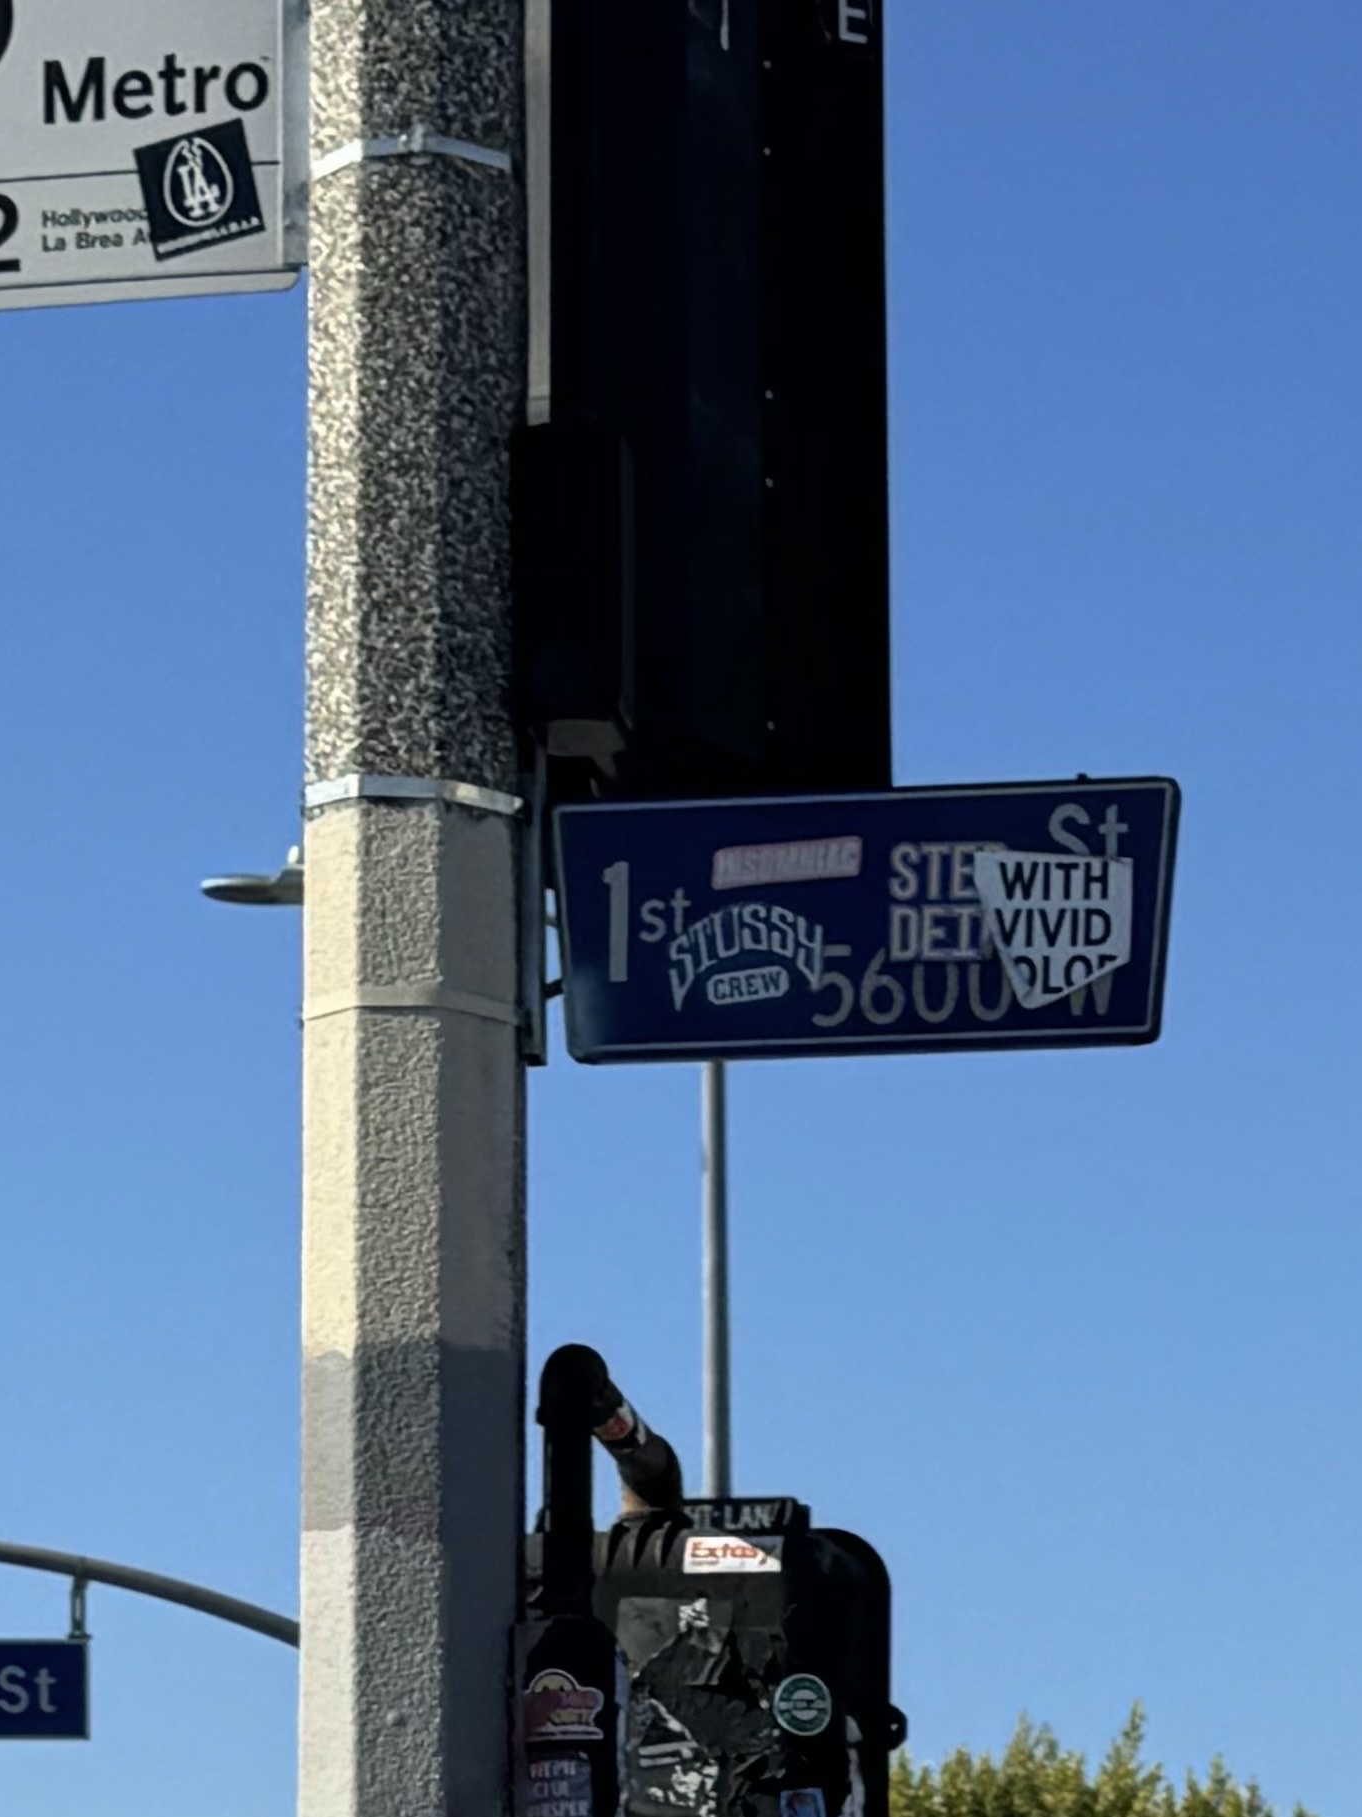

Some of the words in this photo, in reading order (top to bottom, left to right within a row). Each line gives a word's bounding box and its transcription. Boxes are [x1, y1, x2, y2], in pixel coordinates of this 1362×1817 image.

[42, 54, 269, 125] Metro
[41, 233, 67, 253] La
[75, 229, 124, 250] Brea
[999, 860, 1109, 901] WITH
[993, 907, 1112, 948] VIVID
[712, 969, 784, 1001] CREW
